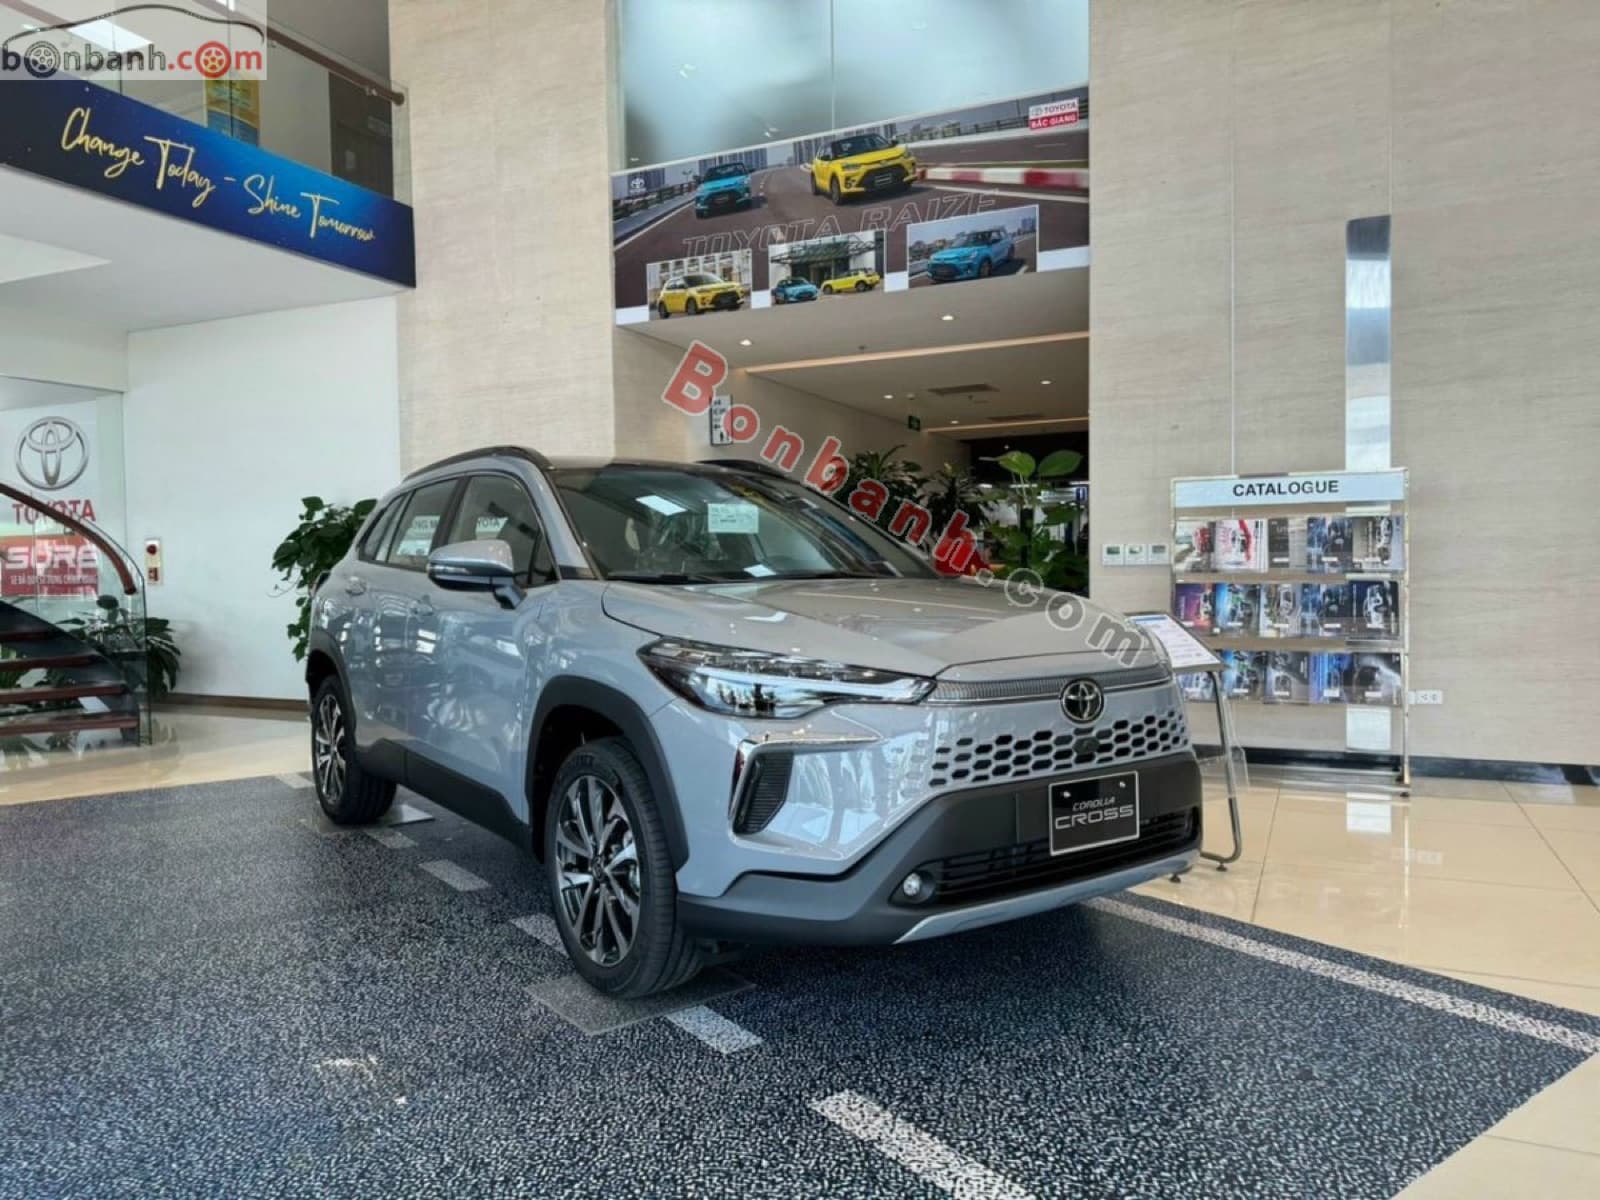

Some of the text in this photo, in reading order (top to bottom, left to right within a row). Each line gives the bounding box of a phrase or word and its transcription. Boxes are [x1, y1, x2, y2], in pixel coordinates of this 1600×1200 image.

[1044, 102, 1076, 113] TOYOTA
[61, 107, 144, 178] Change
[144, 135, 215, 208] Today
[244, 174, 302, 214] Shine
[300, 192, 376, 241] Tomorrow
[682, 215, 842, 255] TOYOTA
[1232, 480, 1339, 497] CATALOGUE
[1072, 796, 1116, 811] COROLLA
[1055, 804, 1134, 829] CROSS
